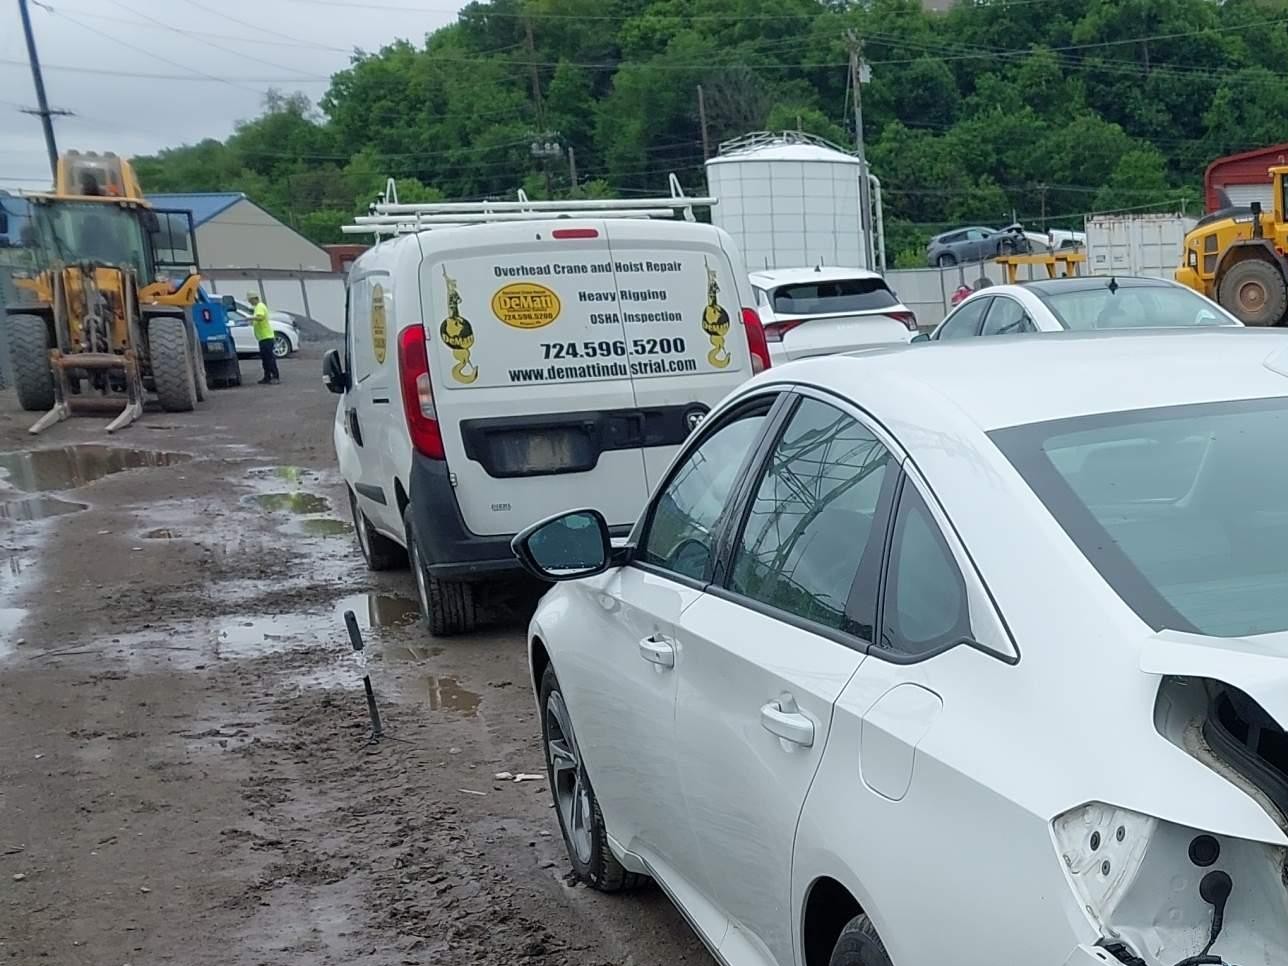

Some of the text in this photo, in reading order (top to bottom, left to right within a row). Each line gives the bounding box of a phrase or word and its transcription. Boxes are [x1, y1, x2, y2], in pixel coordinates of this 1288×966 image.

[494, 261, 682, 277] Overhead Crane and Hoist Repair
[500, 295, 552, 309] DeMatt
[578, 290, 667, 302] Heavy Rigging
[590, 311, 682, 325] OSHA Inspection
[540, 337, 686, 360] 724.596.5200
[508, 357, 697, 383] www.demattindustrial.com
